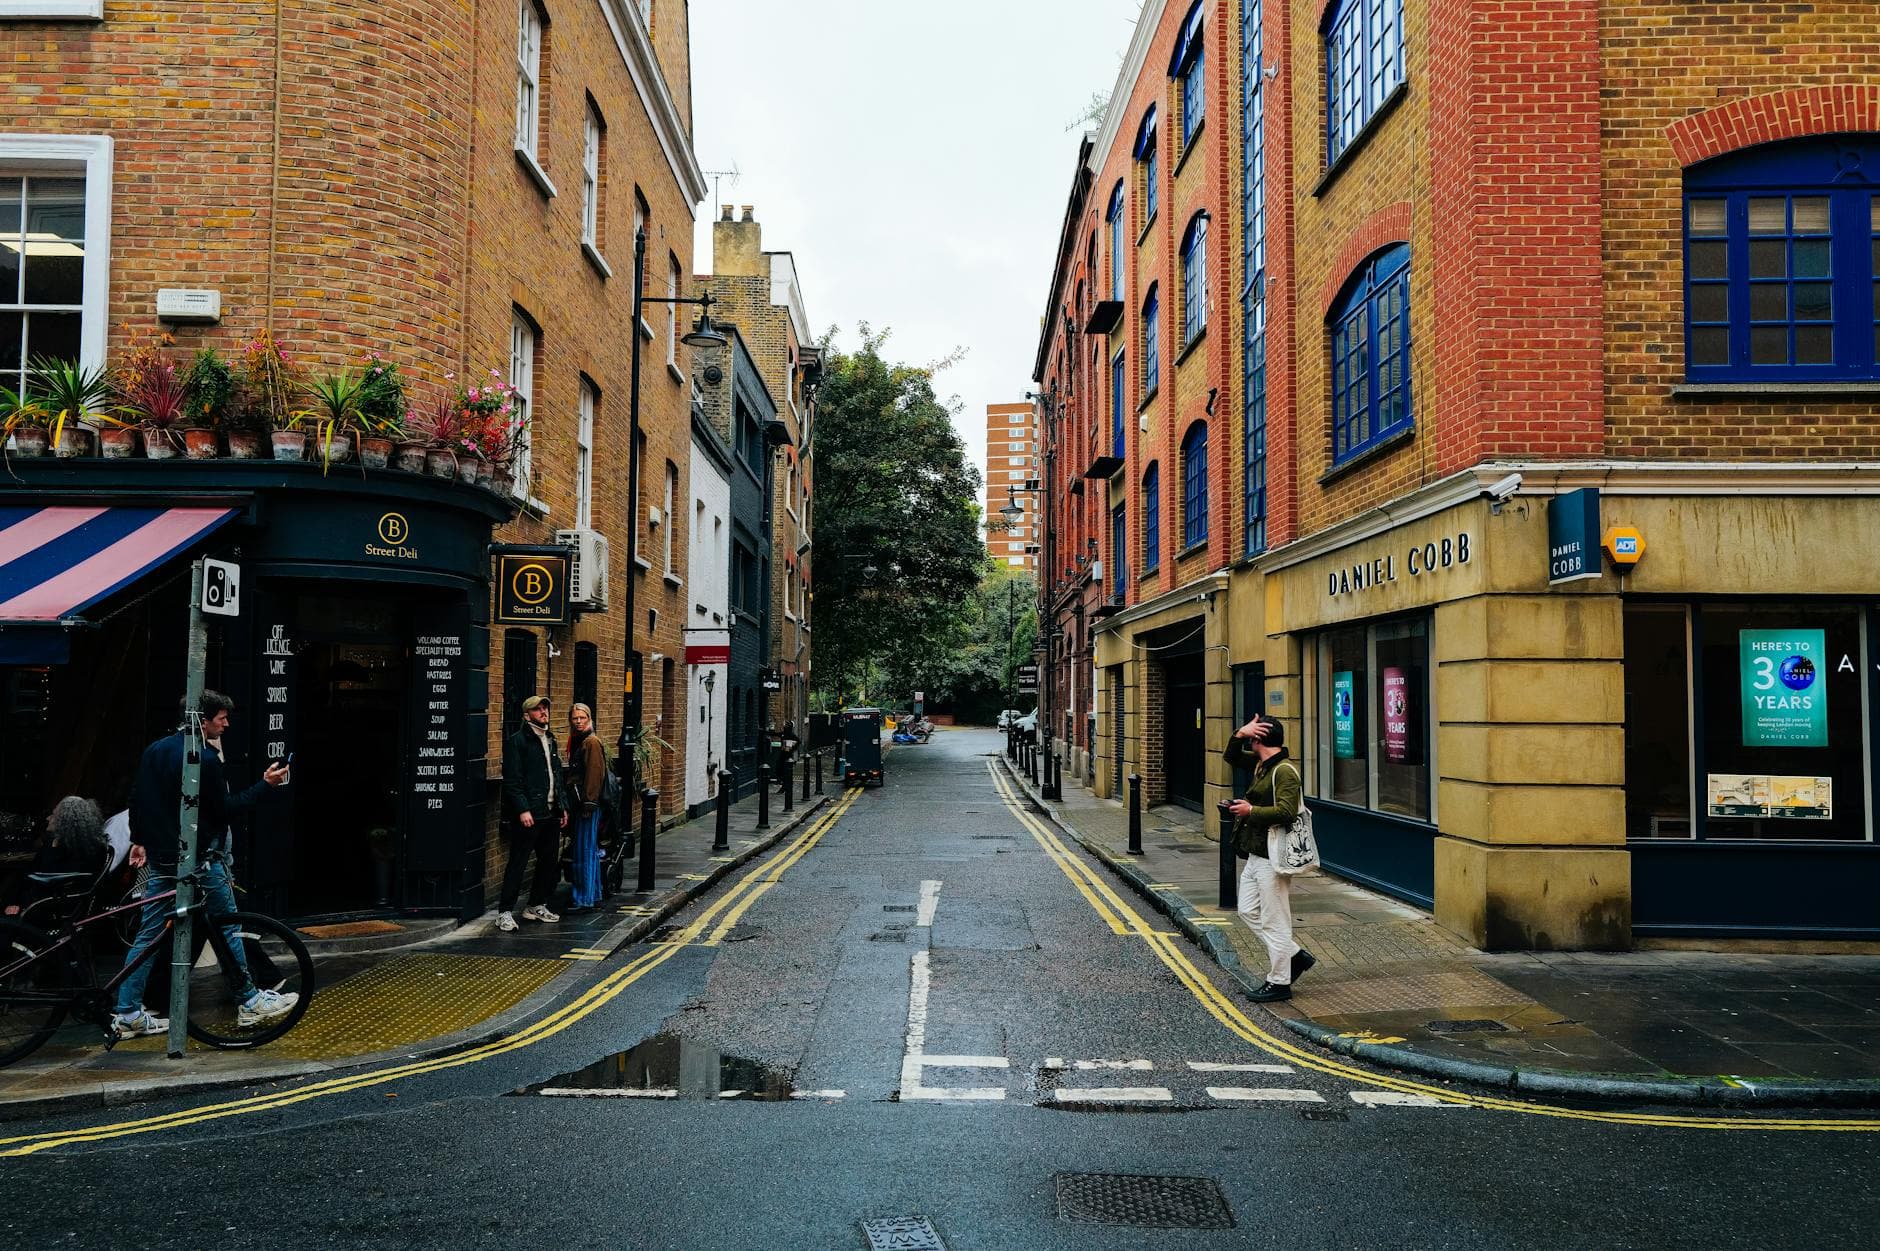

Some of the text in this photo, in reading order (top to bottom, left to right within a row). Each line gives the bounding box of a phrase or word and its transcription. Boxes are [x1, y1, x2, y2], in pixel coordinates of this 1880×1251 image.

[387, 518, 400, 538] B
[365, 544, 418, 560] Street Deli
[1552, 541, 1581, 557] DANIEL
[1616, 541, 1635, 551] ADT
[1329, 533, 1471, 596] DANIEL COBB
[1552, 556, 1582, 576] COBB
[524, 572, 542, 595] B
[513, 605, 551, 615] Street Deli
[271, 625, 283, 640] OFF
[266, 638, 292, 654] LICENCE
[1751, 642, 1810, 651] HERE'S TO
[270, 660, 285, 674] WINE
[267, 687, 287, 702] SPIRITS
[433, 685, 446, 693] EGGS
[429, 701, 448, 709] BUTTER
[1754, 696, 1812, 709] YEARS
[269, 714, 283, 730] BEER
[431, 715, 445, 723] SOUP
[1336, 720, 1351, 731] YEARS
[1387, 722, 1406, 734] YEARS
[428, 731, 448, 740] SALADS
[268, 742, 284, 758] CIDER
[417, 765, 454, 775] SCOTCH EGGS
[428, 799, 442, 808] PIES
